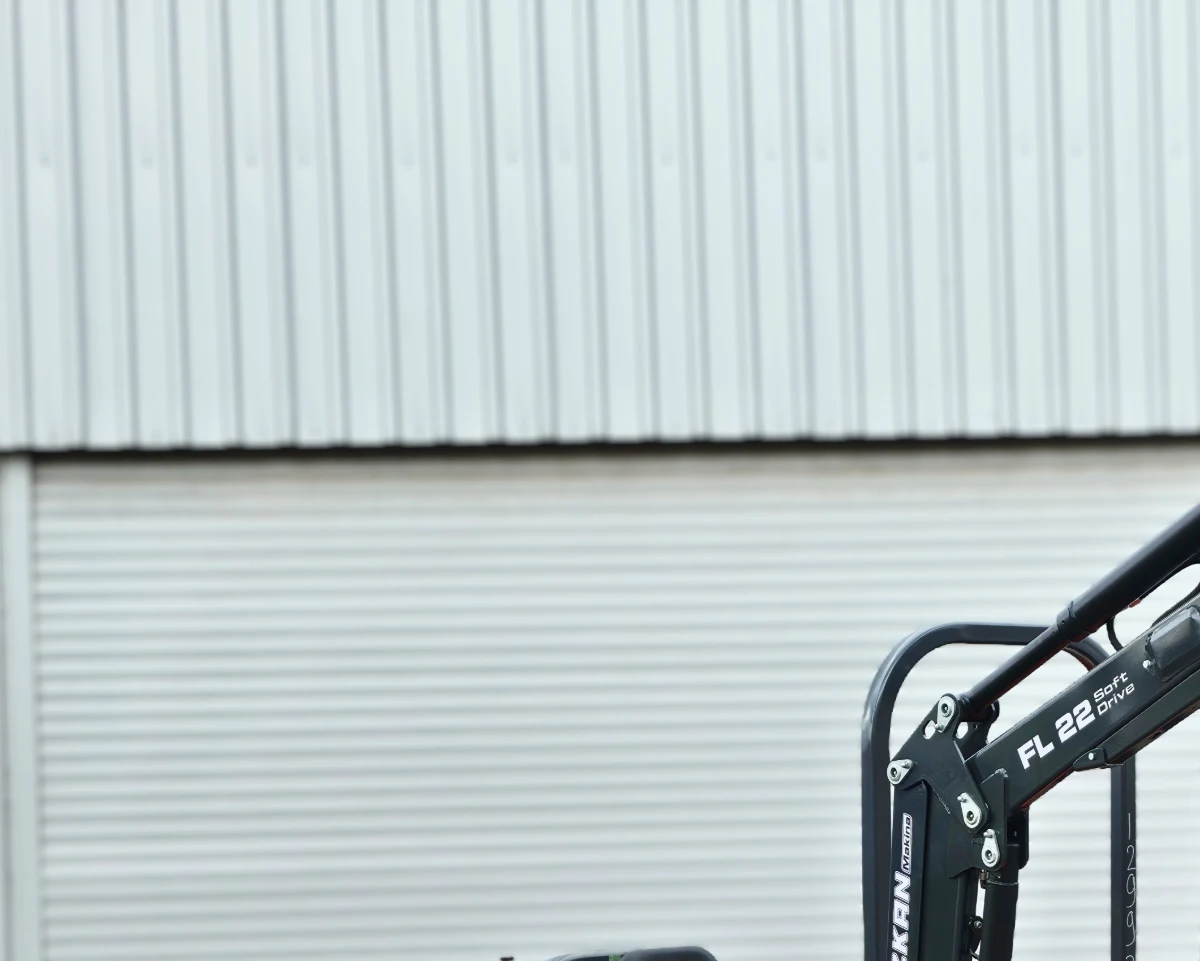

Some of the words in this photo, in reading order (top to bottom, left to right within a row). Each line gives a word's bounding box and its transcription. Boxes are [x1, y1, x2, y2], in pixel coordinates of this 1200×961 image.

[1093, 672, 1129, 702] Soft
[1097, 683, 1135, 715] Drive
[1017, 734, 1055, 770] FL
[1055, 699, 1096, 744] 22
[902, 816, 912, 872] Makina
